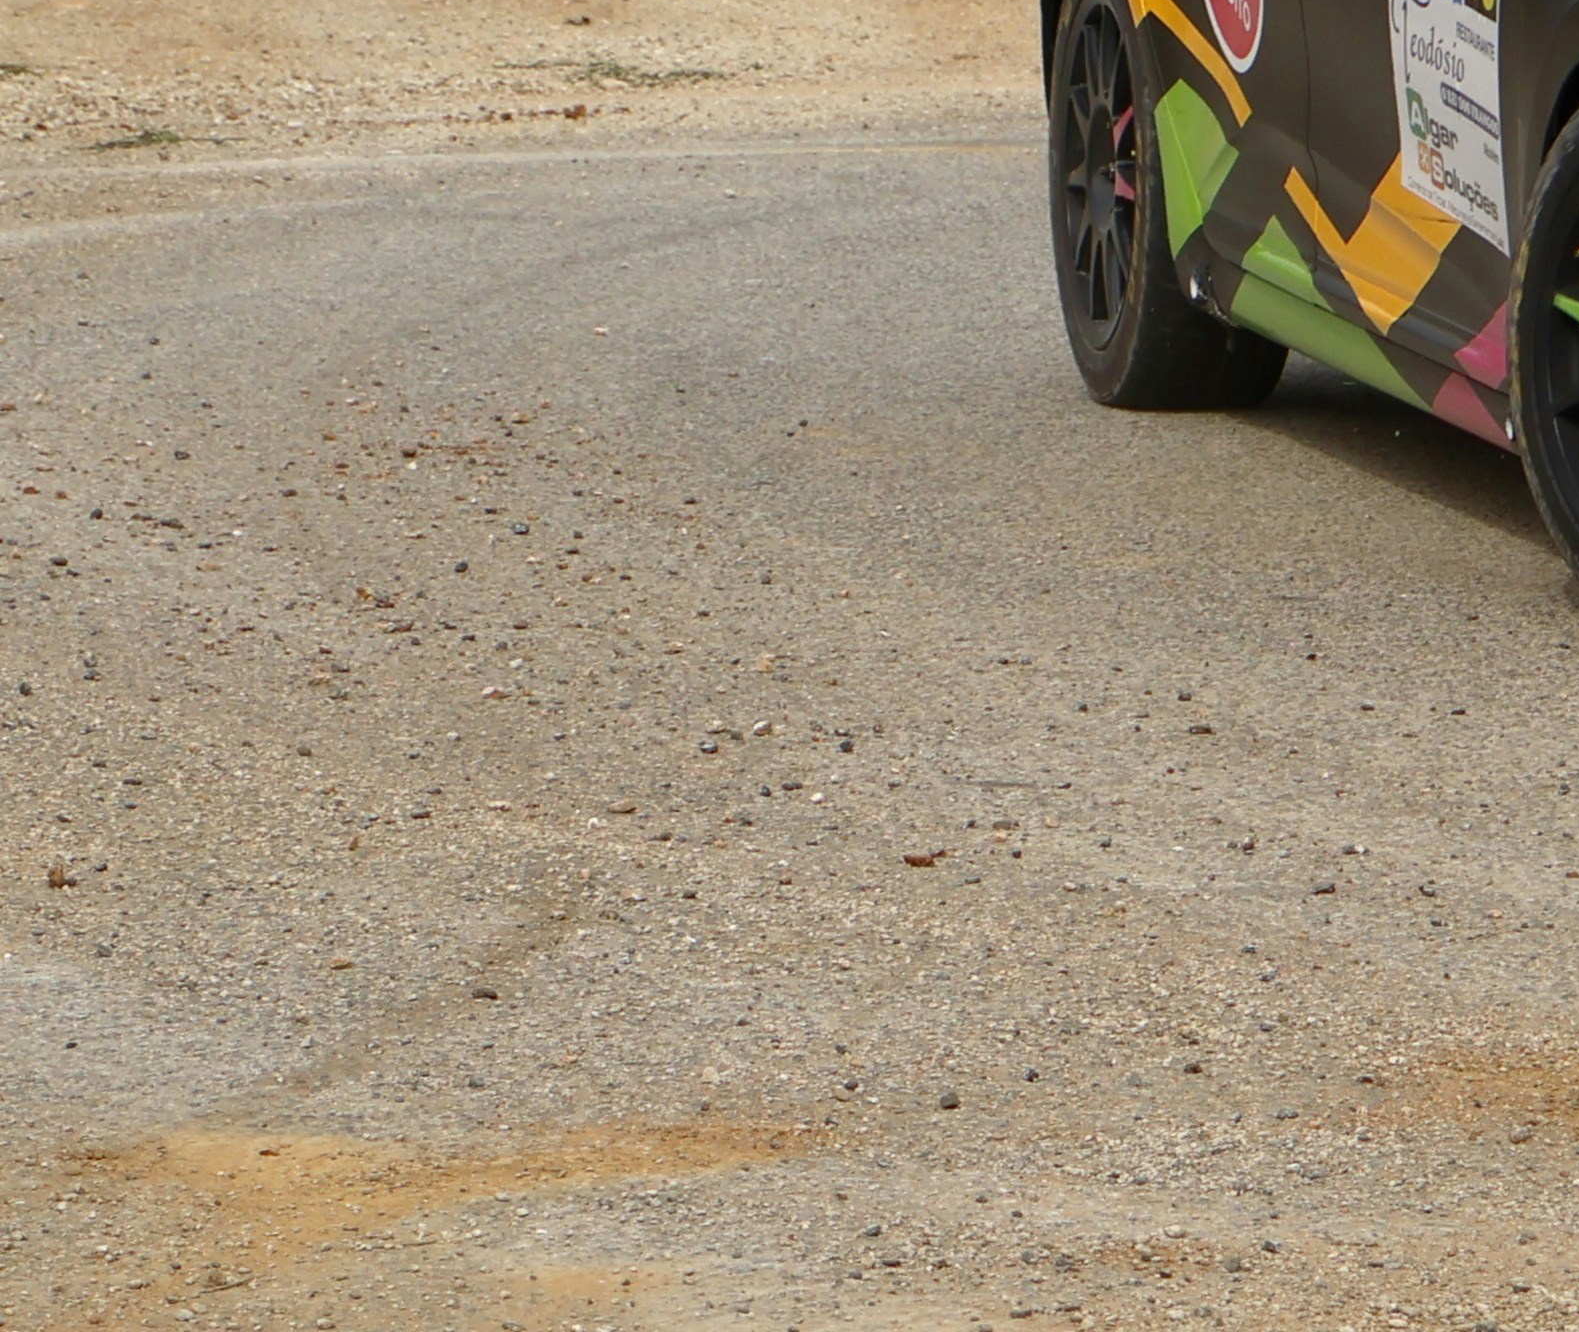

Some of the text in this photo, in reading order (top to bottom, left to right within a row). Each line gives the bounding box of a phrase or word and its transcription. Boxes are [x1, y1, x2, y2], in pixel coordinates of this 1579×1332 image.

[1455, 21, 1495, 62] RESTAURANTE
[1407, 91, 1458, 151] Algar
[1432, 152, 1499, 222] Soluções
